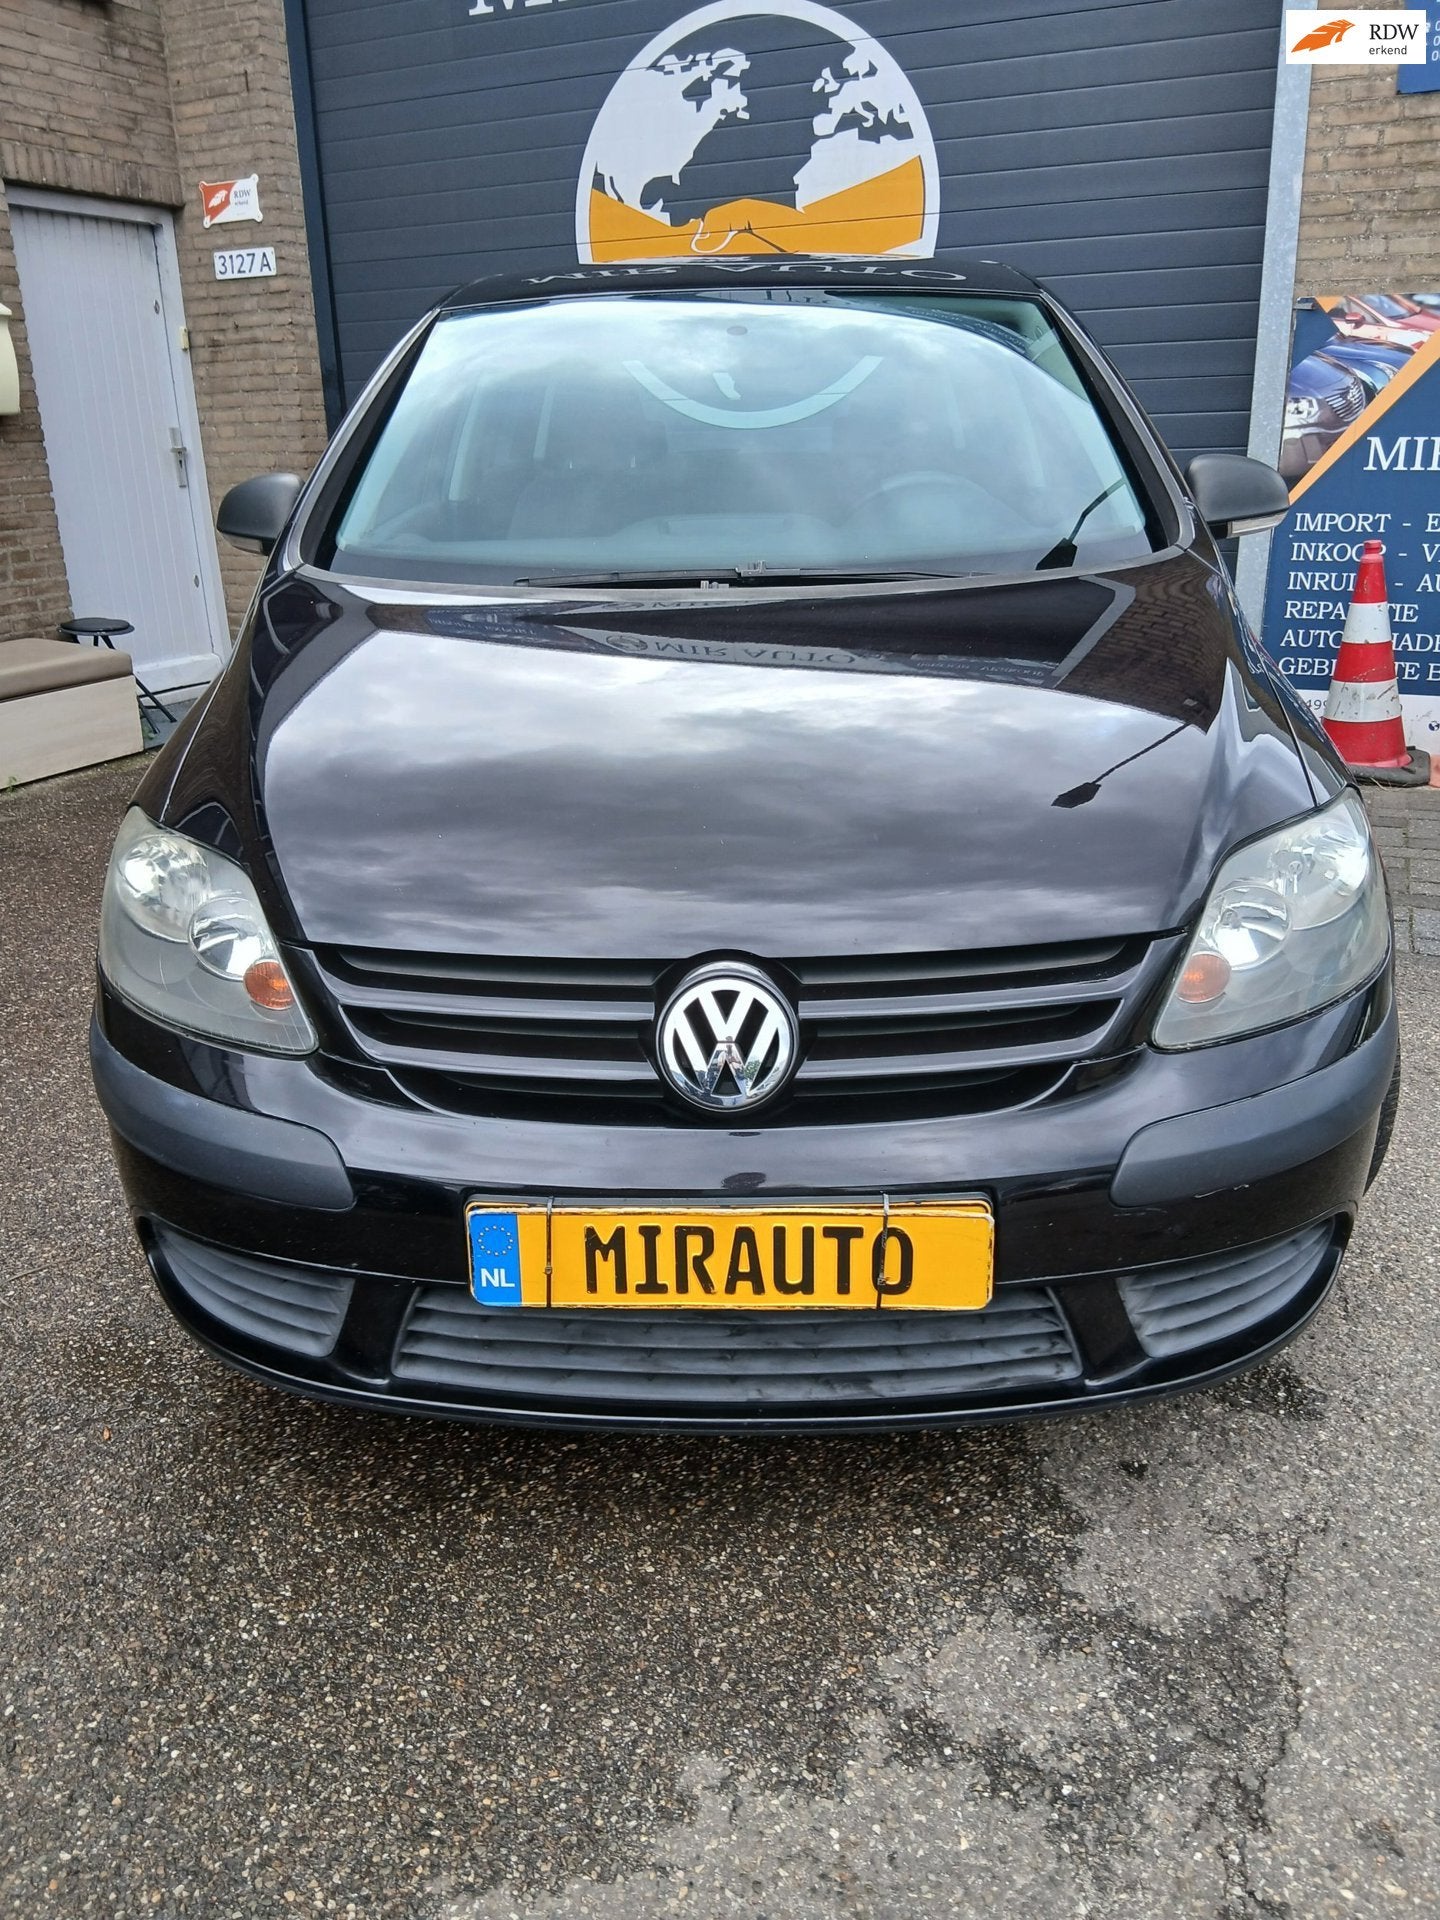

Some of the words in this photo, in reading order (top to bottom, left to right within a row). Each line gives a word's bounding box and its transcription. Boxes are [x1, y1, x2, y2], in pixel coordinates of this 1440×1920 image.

[1294, 512, 1392, 533] IMPORT
[1287, 571, 1357, 592] INRUI
[480, 1268, 515, 1288] NL
[585, 1225, 914, 1295] MIRAUTO
